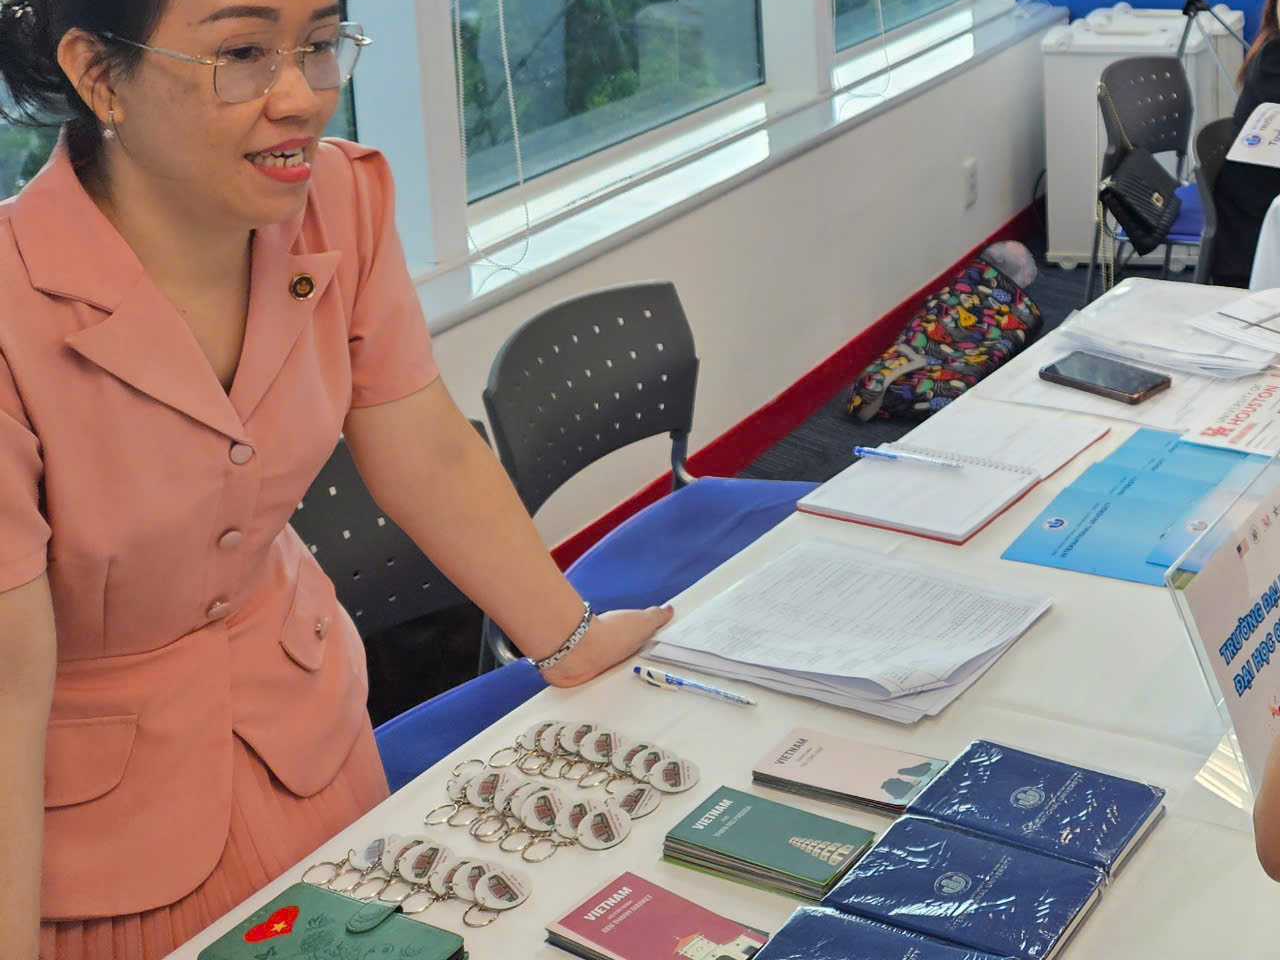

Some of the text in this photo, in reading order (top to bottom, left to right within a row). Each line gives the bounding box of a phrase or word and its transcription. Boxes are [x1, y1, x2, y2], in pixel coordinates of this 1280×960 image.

[1226, 384, 1280, 426] HOUSTON
[1219, 602, 1266, 666] TRƯỜNG
[1233, 658, 1256, 697] ĐẠI
[1251, 632, 1276, 673] HỌC
[775, 738, 808, 765] VIETNAM
[692, 799, 734, 830] VIETNAM
[584, 886, 632, 921] VIETNAM
